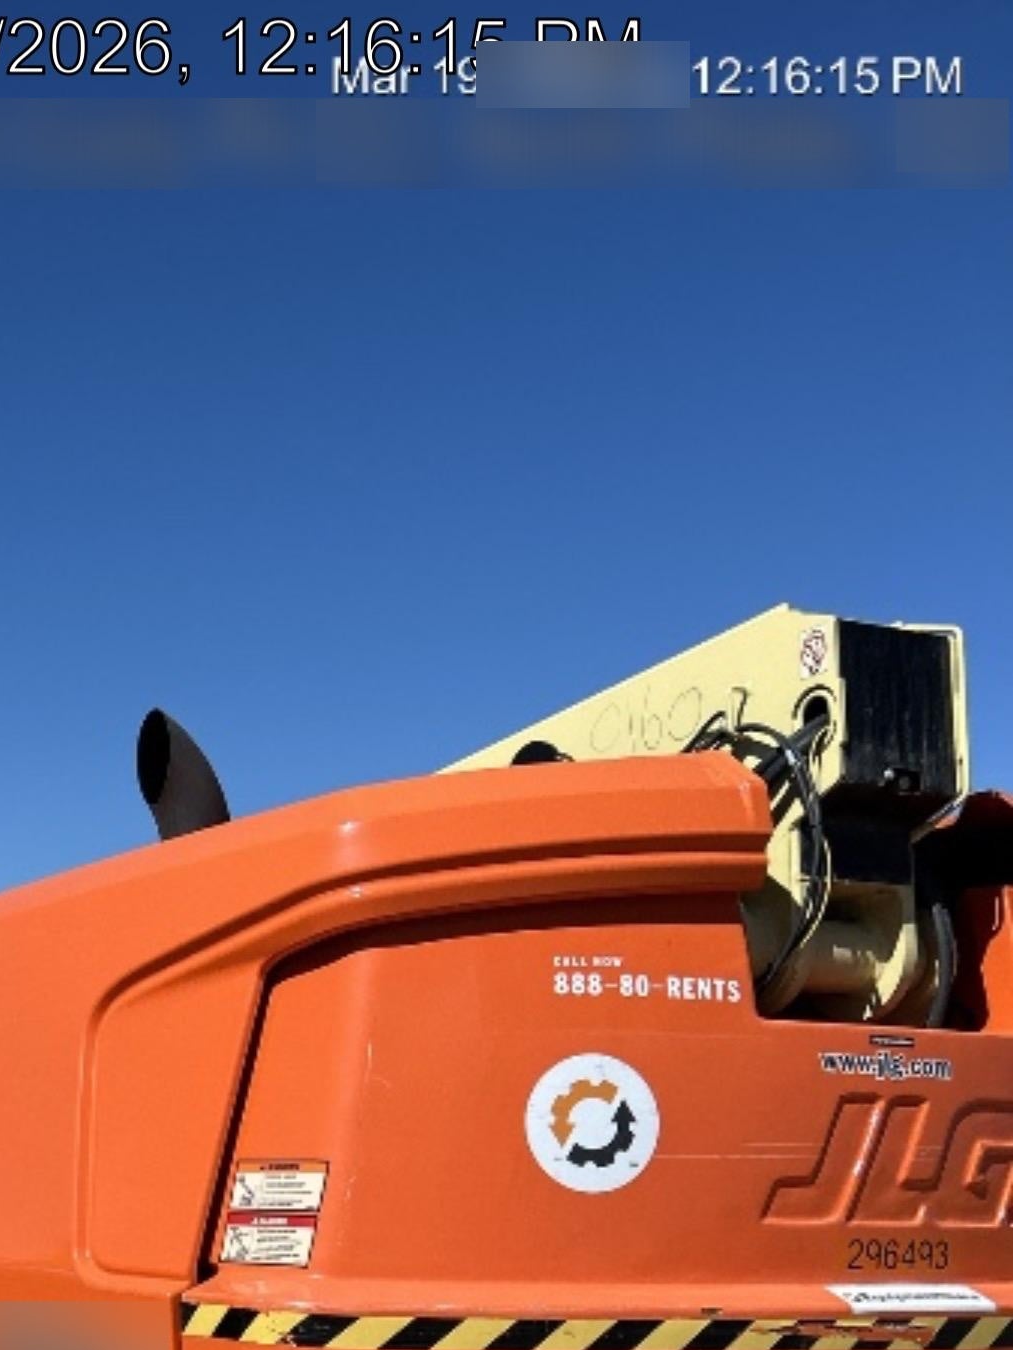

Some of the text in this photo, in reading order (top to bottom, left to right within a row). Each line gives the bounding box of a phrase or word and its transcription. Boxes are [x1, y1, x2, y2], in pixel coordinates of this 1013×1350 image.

[553, 972, 742, 1003] 888-80-RENTS
[822, 1051, 951, 1080] www.jlg.com
[760, 1091, 1013, 1227] JLG
[847, 1238, 950, 1271] 296493
